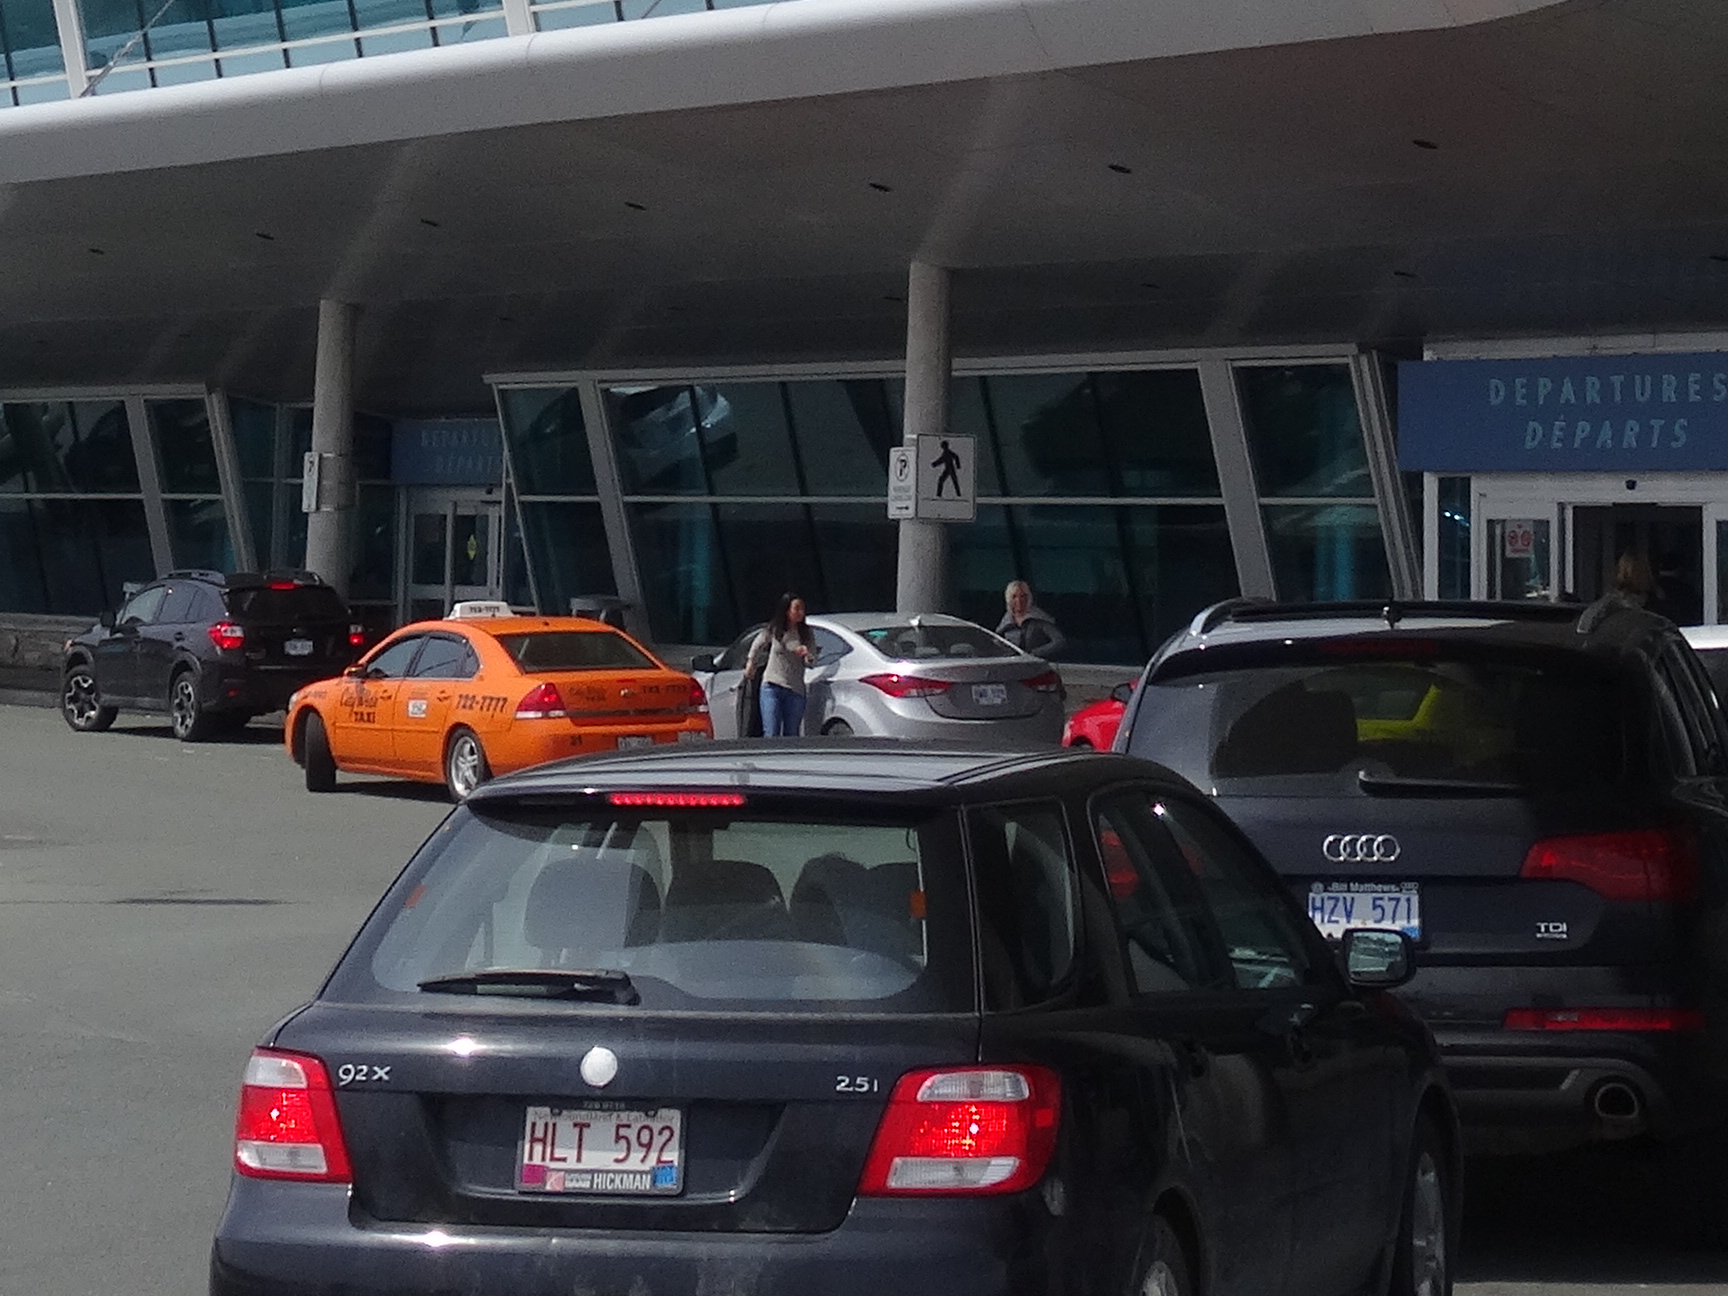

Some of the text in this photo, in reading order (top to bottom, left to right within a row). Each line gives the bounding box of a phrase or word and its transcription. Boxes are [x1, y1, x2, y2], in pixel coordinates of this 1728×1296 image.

[1488, 373, 1728, 406] DEPARTURES
[1524, 415, 1688, 450] DÉPARTS
[353, 711, 376, 723] TAXI
[1311, 896, 1411, 924] HZV 571
[1536, 922, 1567, 933] TDI
[527, 1121, 675, 1164] HLT 592
[592, 1172, 651, 1190] HICKMAN
